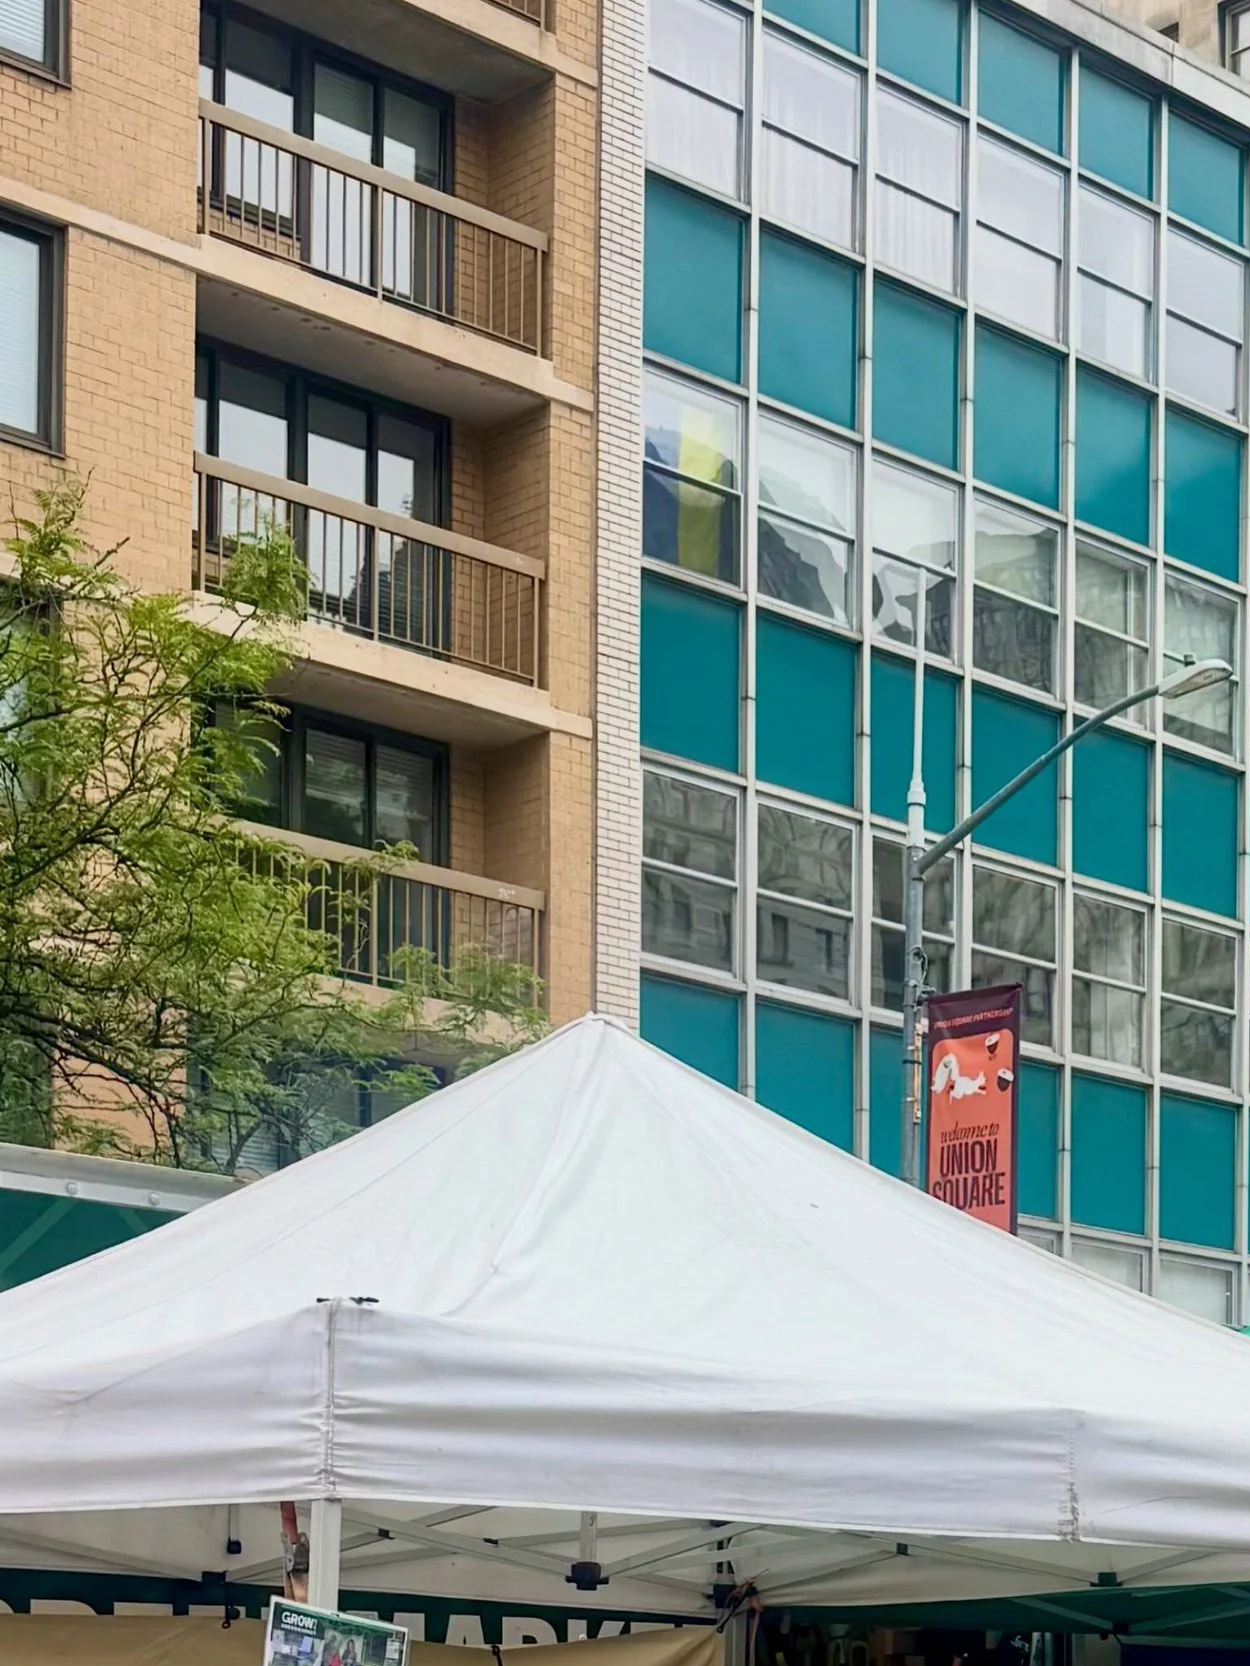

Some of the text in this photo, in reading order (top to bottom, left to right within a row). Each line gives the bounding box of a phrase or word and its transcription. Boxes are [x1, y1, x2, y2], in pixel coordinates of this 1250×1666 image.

[940, 1122, 1001, 1145] welcome to
[939, 1139, 999, 1179] UNION
[932, 1172, 1006, 1211] SQUARE
